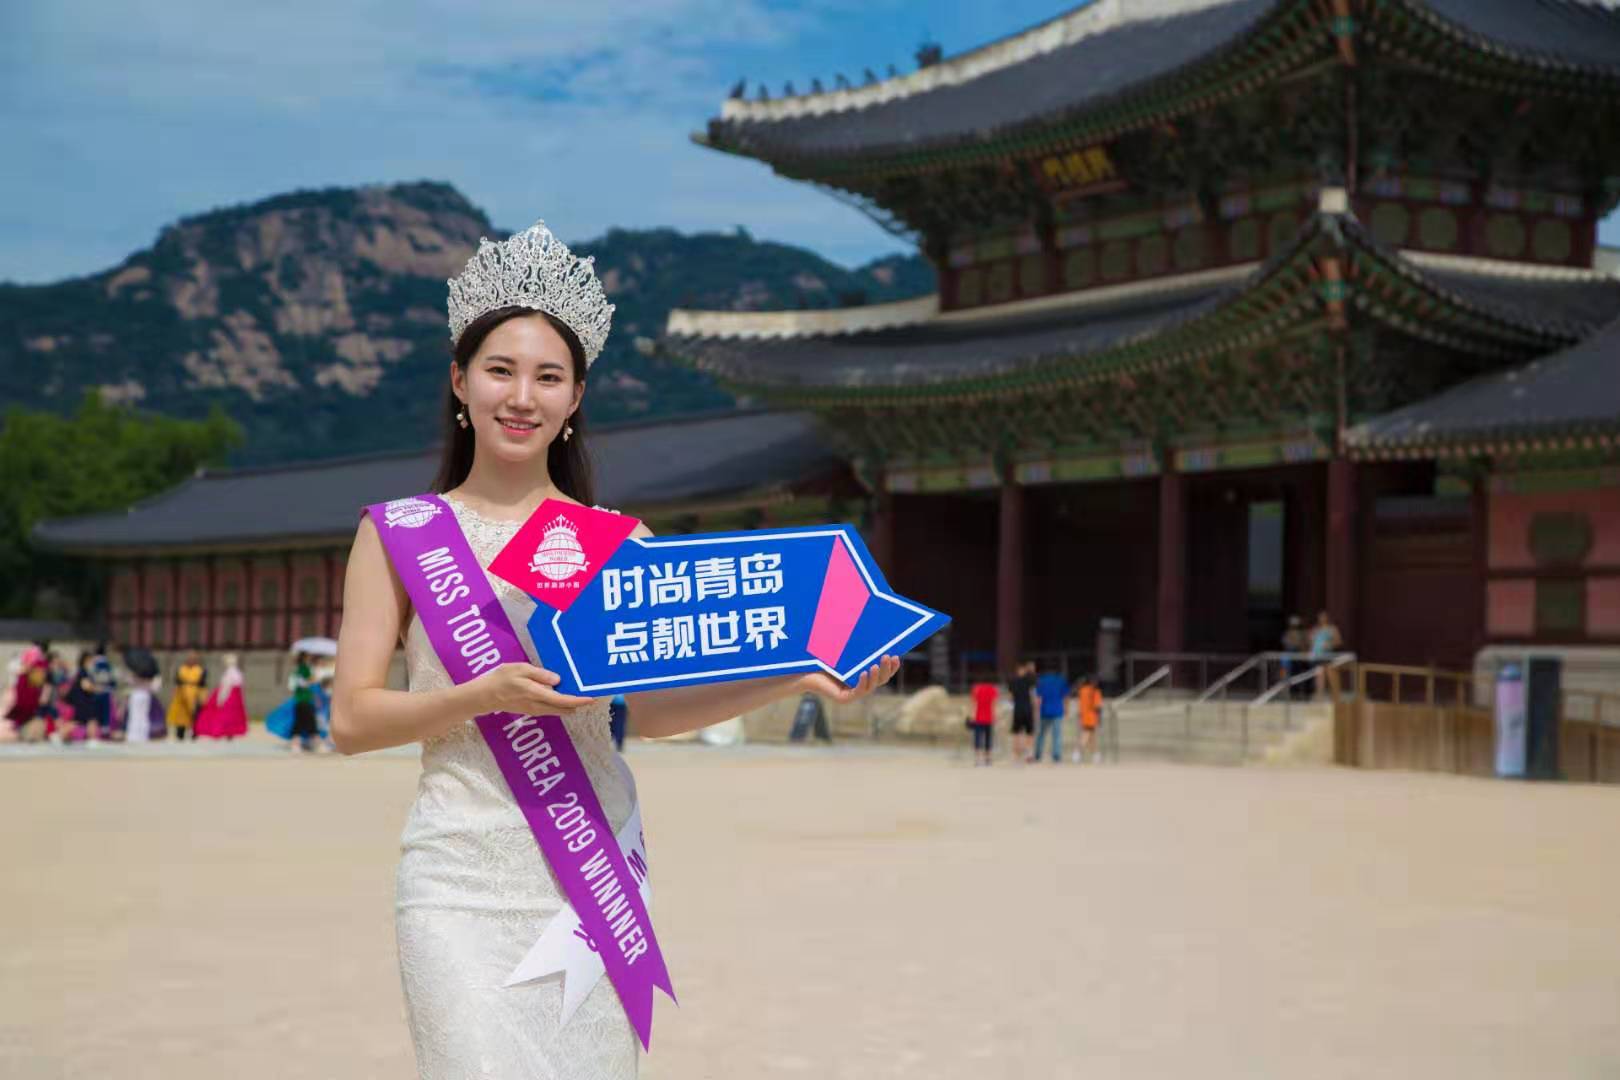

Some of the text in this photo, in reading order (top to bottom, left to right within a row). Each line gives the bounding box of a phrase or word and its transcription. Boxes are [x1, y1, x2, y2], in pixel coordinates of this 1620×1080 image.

[602, 552, 784, 611] 时尚青岛
[606, 605, 789, 666] 点靓世界
[416, 546, 470, 606] MISS
[446, 603, 501, 674] TOUR
[502, 714, 566, 797] KOREA
[546, 792, 597, 853] 2019
[579, 848, 649, 965] WINNNER
